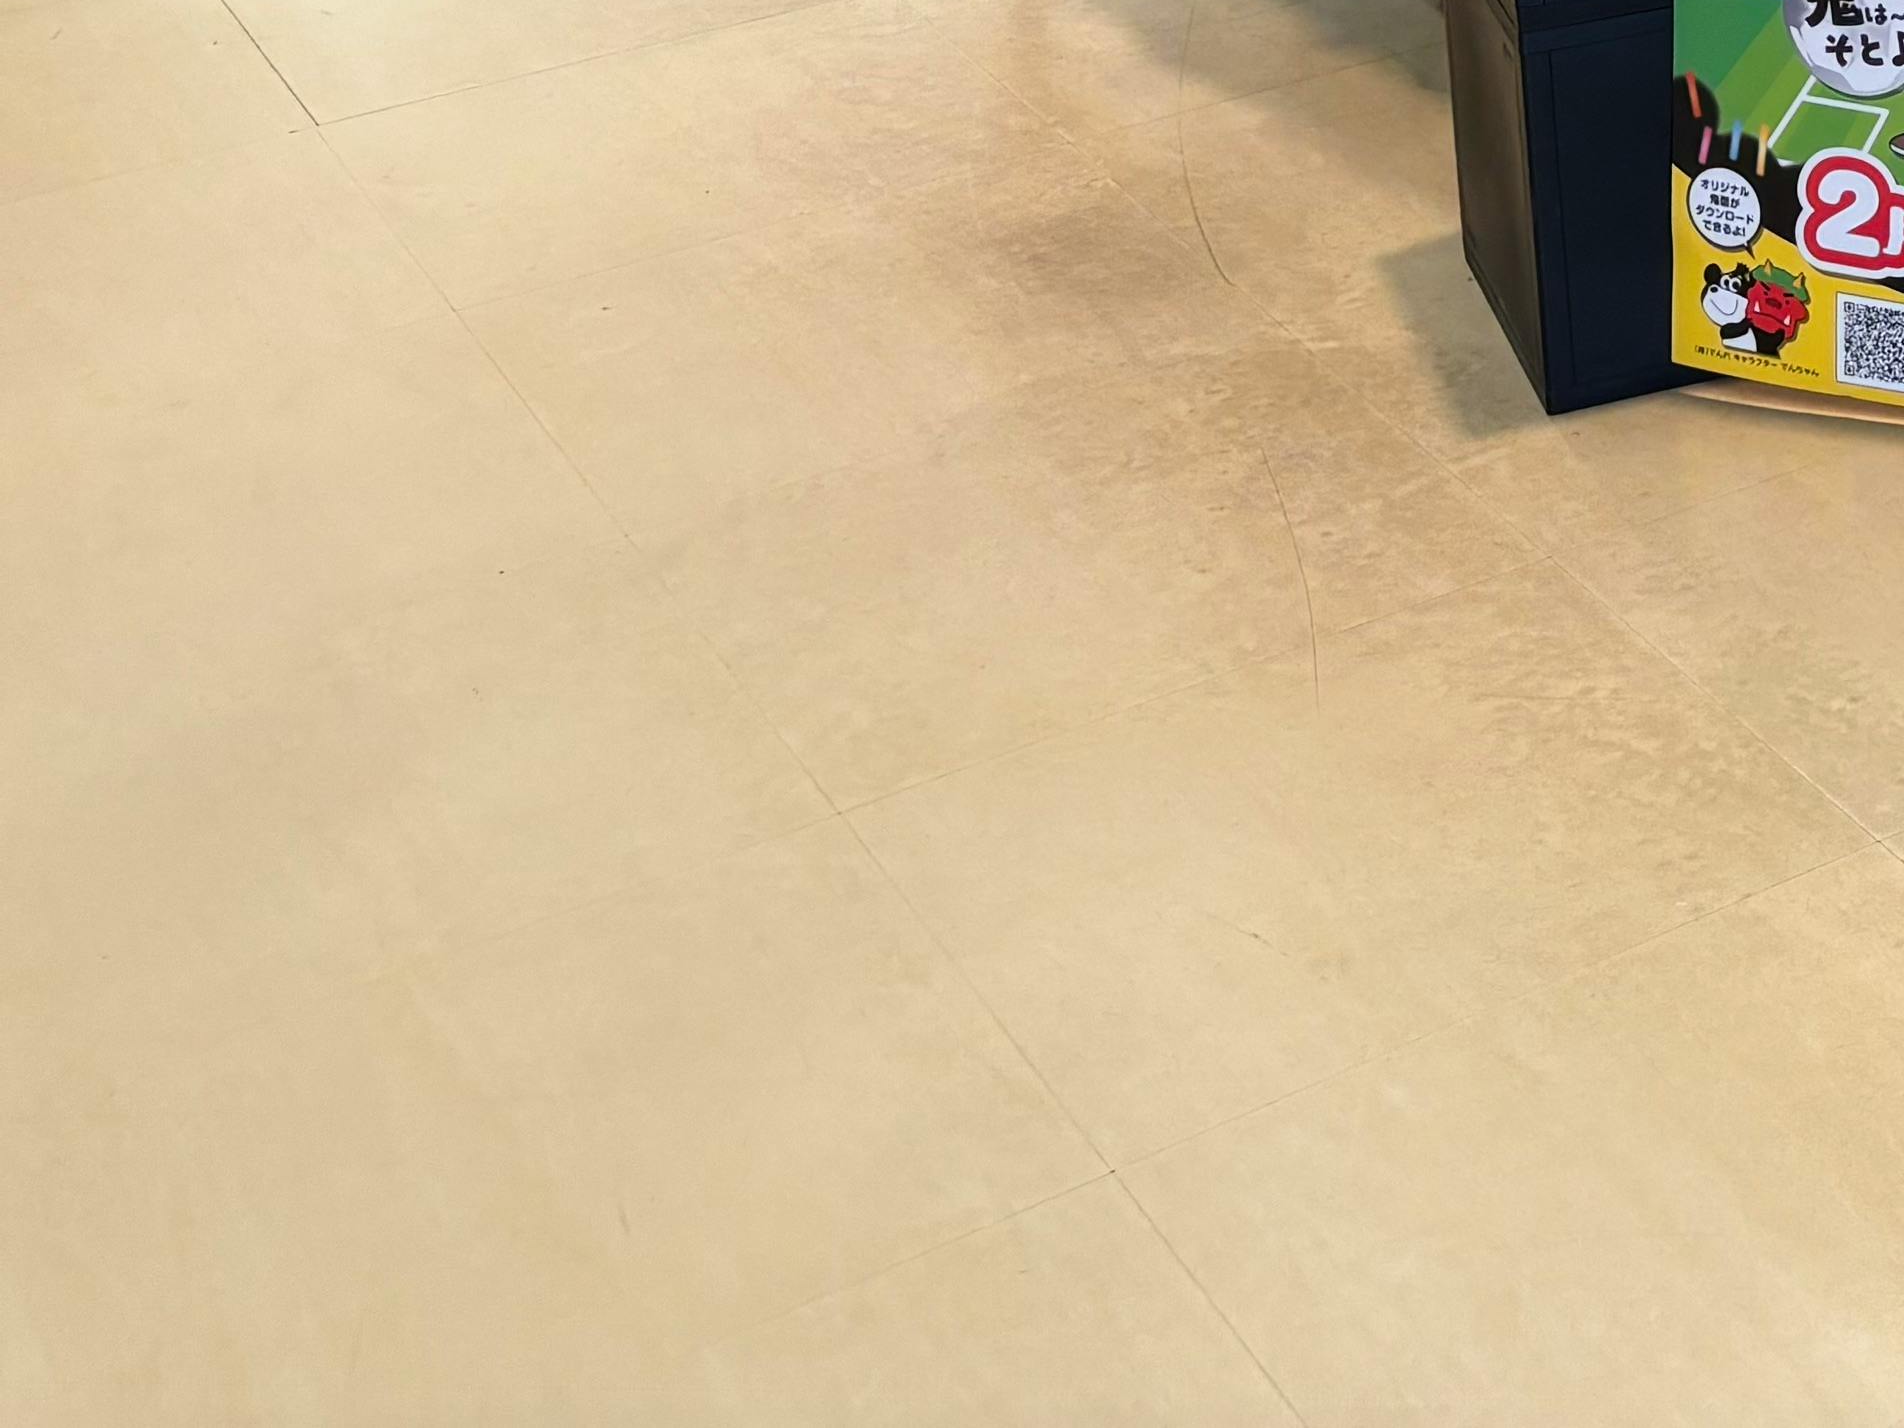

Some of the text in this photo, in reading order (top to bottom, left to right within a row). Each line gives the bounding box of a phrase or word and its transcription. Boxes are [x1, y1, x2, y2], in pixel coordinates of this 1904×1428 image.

[1700, 178, 1750, 197] オリジナル
[1695, 204, 1755, 225] ダウンロード
